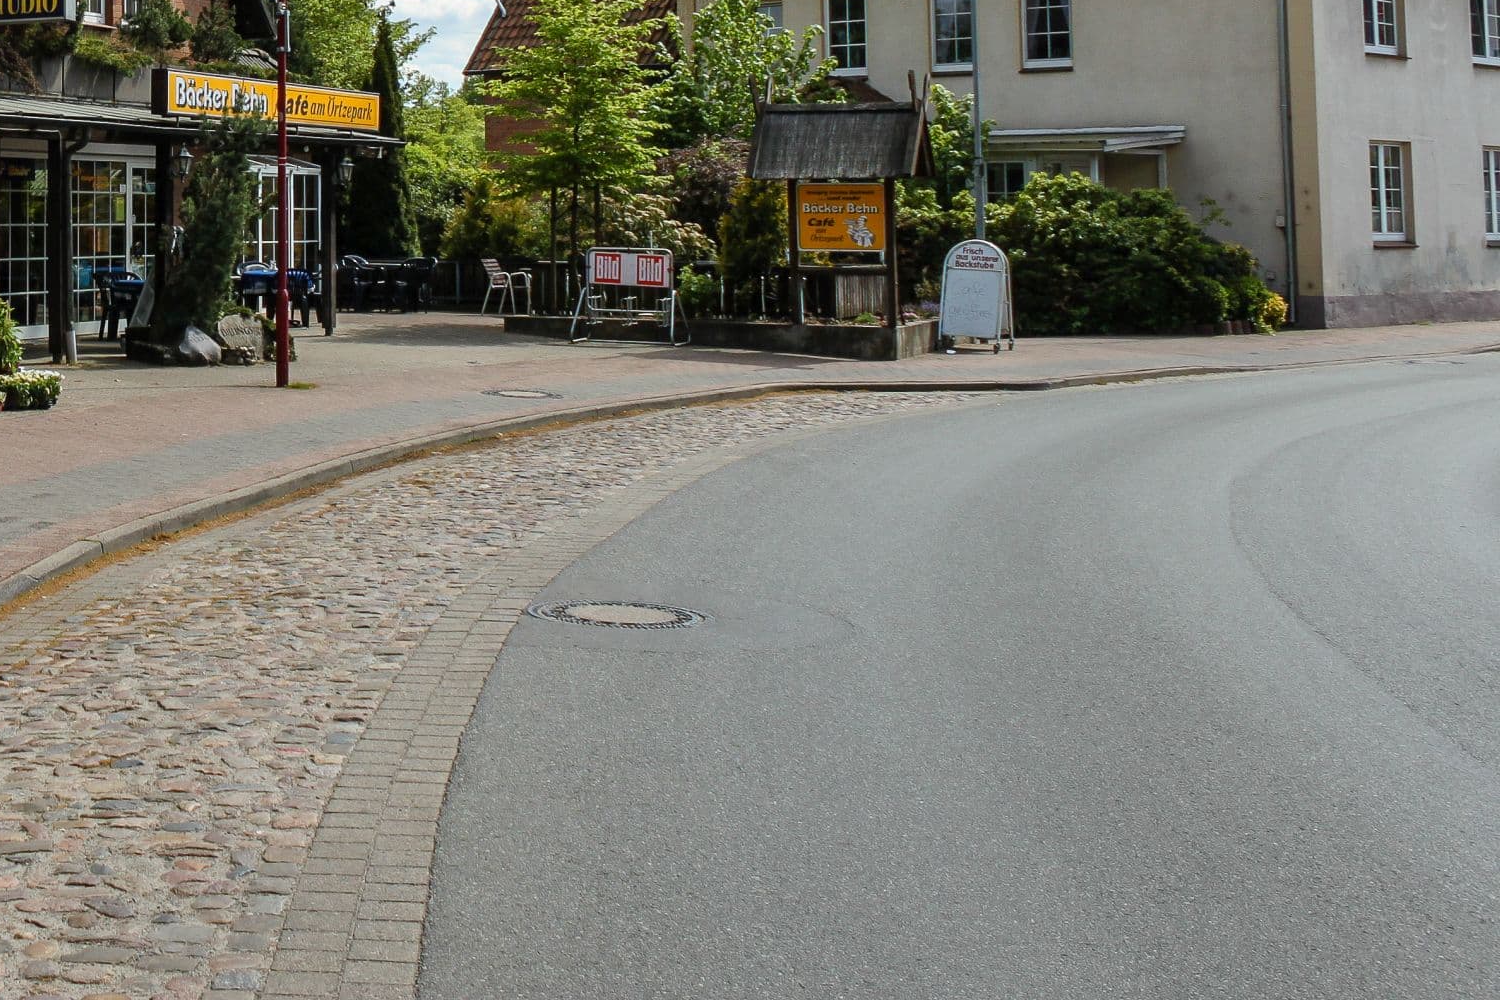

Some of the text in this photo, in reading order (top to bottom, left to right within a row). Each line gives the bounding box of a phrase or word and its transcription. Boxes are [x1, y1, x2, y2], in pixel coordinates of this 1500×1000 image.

[175, 76, 228, 111] Bäcker
[277, 92, 309, 116] afé
[311, 102, 325, 116] am
[327, 96, 373, 122] Örtzepark
[803, 203, 878, 214] Bäcker Behn
[808, 217, 836, 226] Café
[962, 247, 983, 255] Frisch
[596, 255, 662, 282] Bild Bild
[955, 260, 994, 269] Backstube
